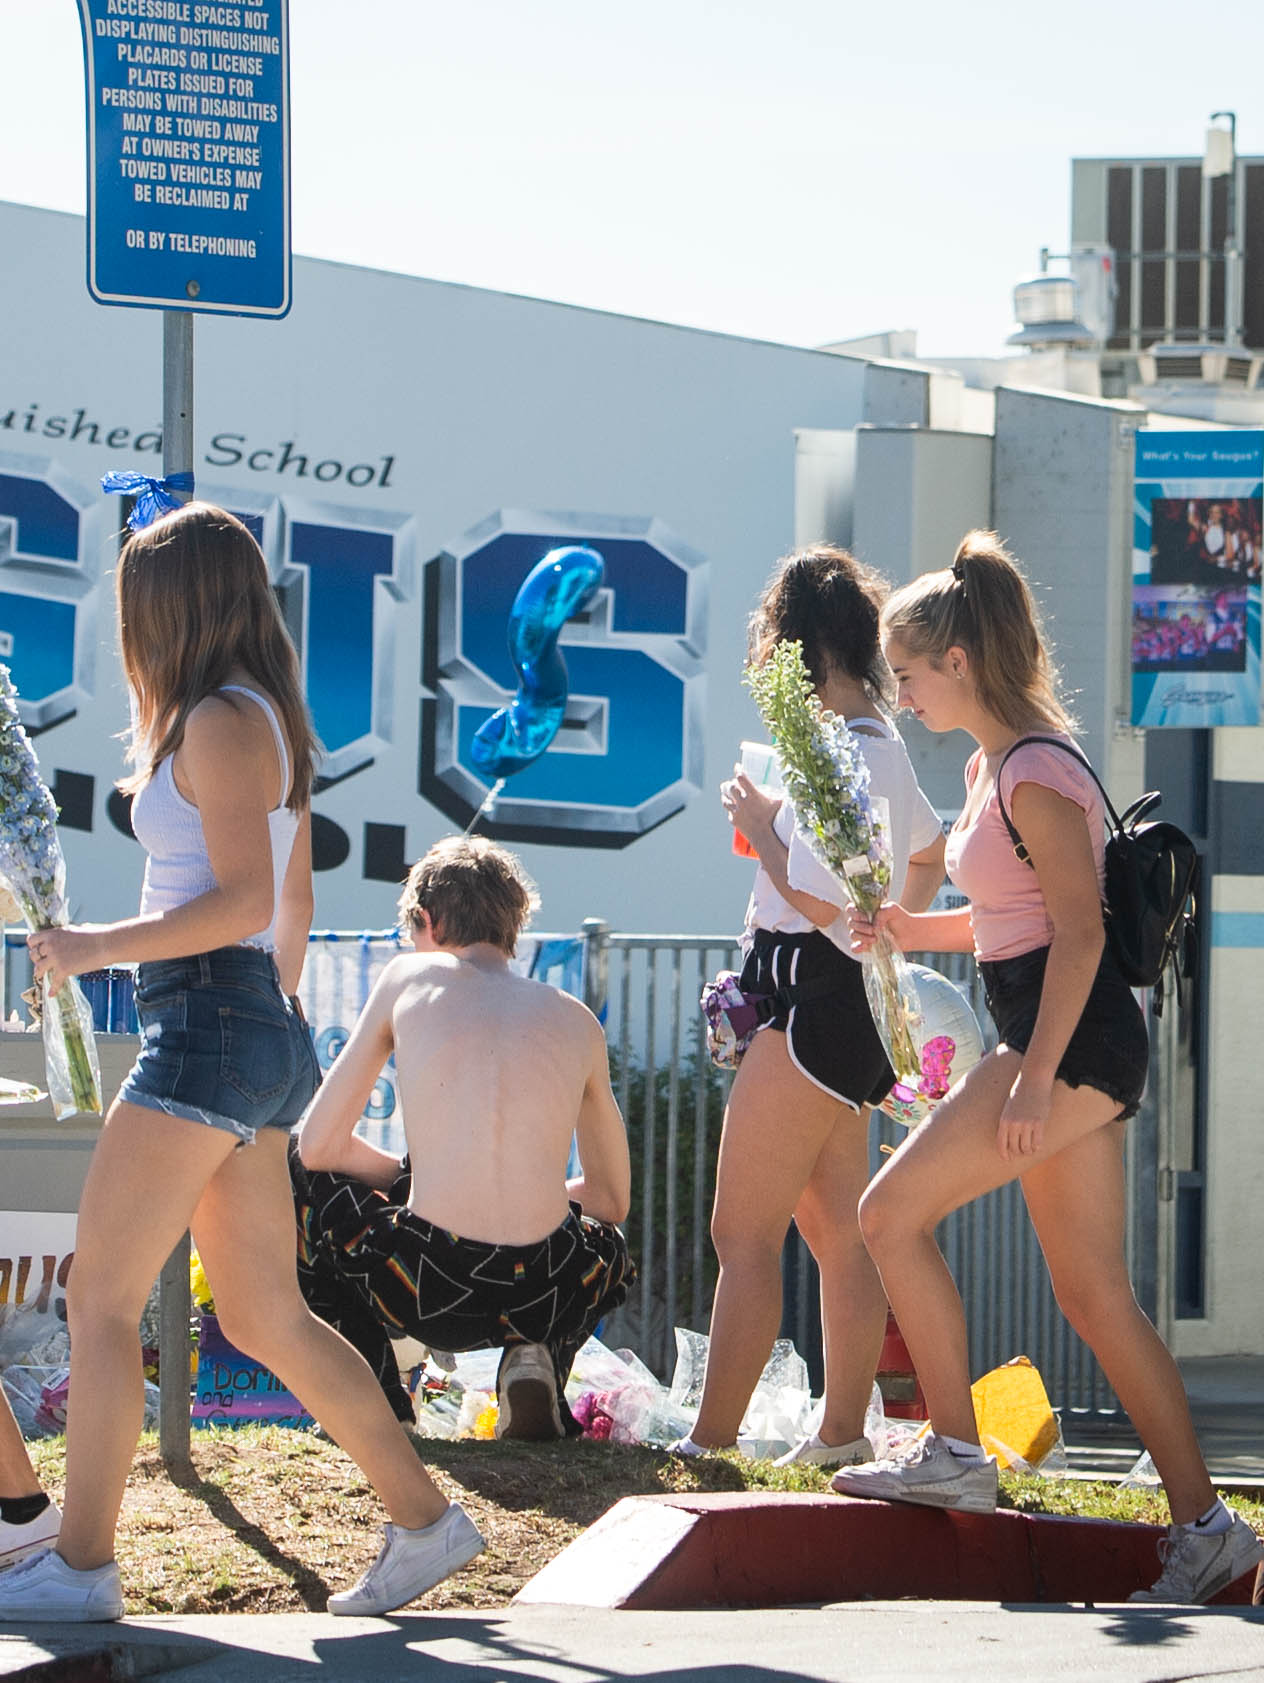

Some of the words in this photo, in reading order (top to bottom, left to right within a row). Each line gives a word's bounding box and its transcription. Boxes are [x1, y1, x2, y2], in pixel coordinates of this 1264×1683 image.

[107, 0, 190, 22] ACCESSIBLE
[194, 4, 240, 27] SPACES
[244, 12, 269, 31] NOT
[96, 19, 176, 43] DISPLAYING
[180, 26, 280, 55] DISTINGUISHING
[118, 43, 187, 67] PLACARDS
[190, 51, 208, 70] OR
[212, 54, 263, 76] LICENSE
[128, 67, 176, 89] PLATES
[180, 73, 225, 94] ISSUED
[229, 78, 254, 98] FOR
[102, 87, 162, 110] PERSONS
[166, 93, 197, 114] WITH
[201, 97, 278, 122] DISABILITIES
[123, 112, 151, 133] MAY
[155, 115, 172, 134] BE
[176, 118, 221, 140] TOWED
[224, 123, 259, 143] AWAY
[122, 136, 138, 154] AT
[142, 138, 201, 161] OWNER'S
[204, 145, 260, 166] EXPENSE
[120, 159, 166, 181] TOWED
[170, 163, 231, 187] VEHICLES
[235, 170, 263, 190] MAY
[135, 183, 152, 202] BE
[156, 185, 230, 209] RECLAIMED
[233, 193, 249, 211] AT
[126, 229, 145, 249] OR
[149, 232, 165, 250] BY
[168, 233, 257, 258] TELEPHONING
[204, 432, 397, 489] School
[201, 1390, 234, 1408] and
